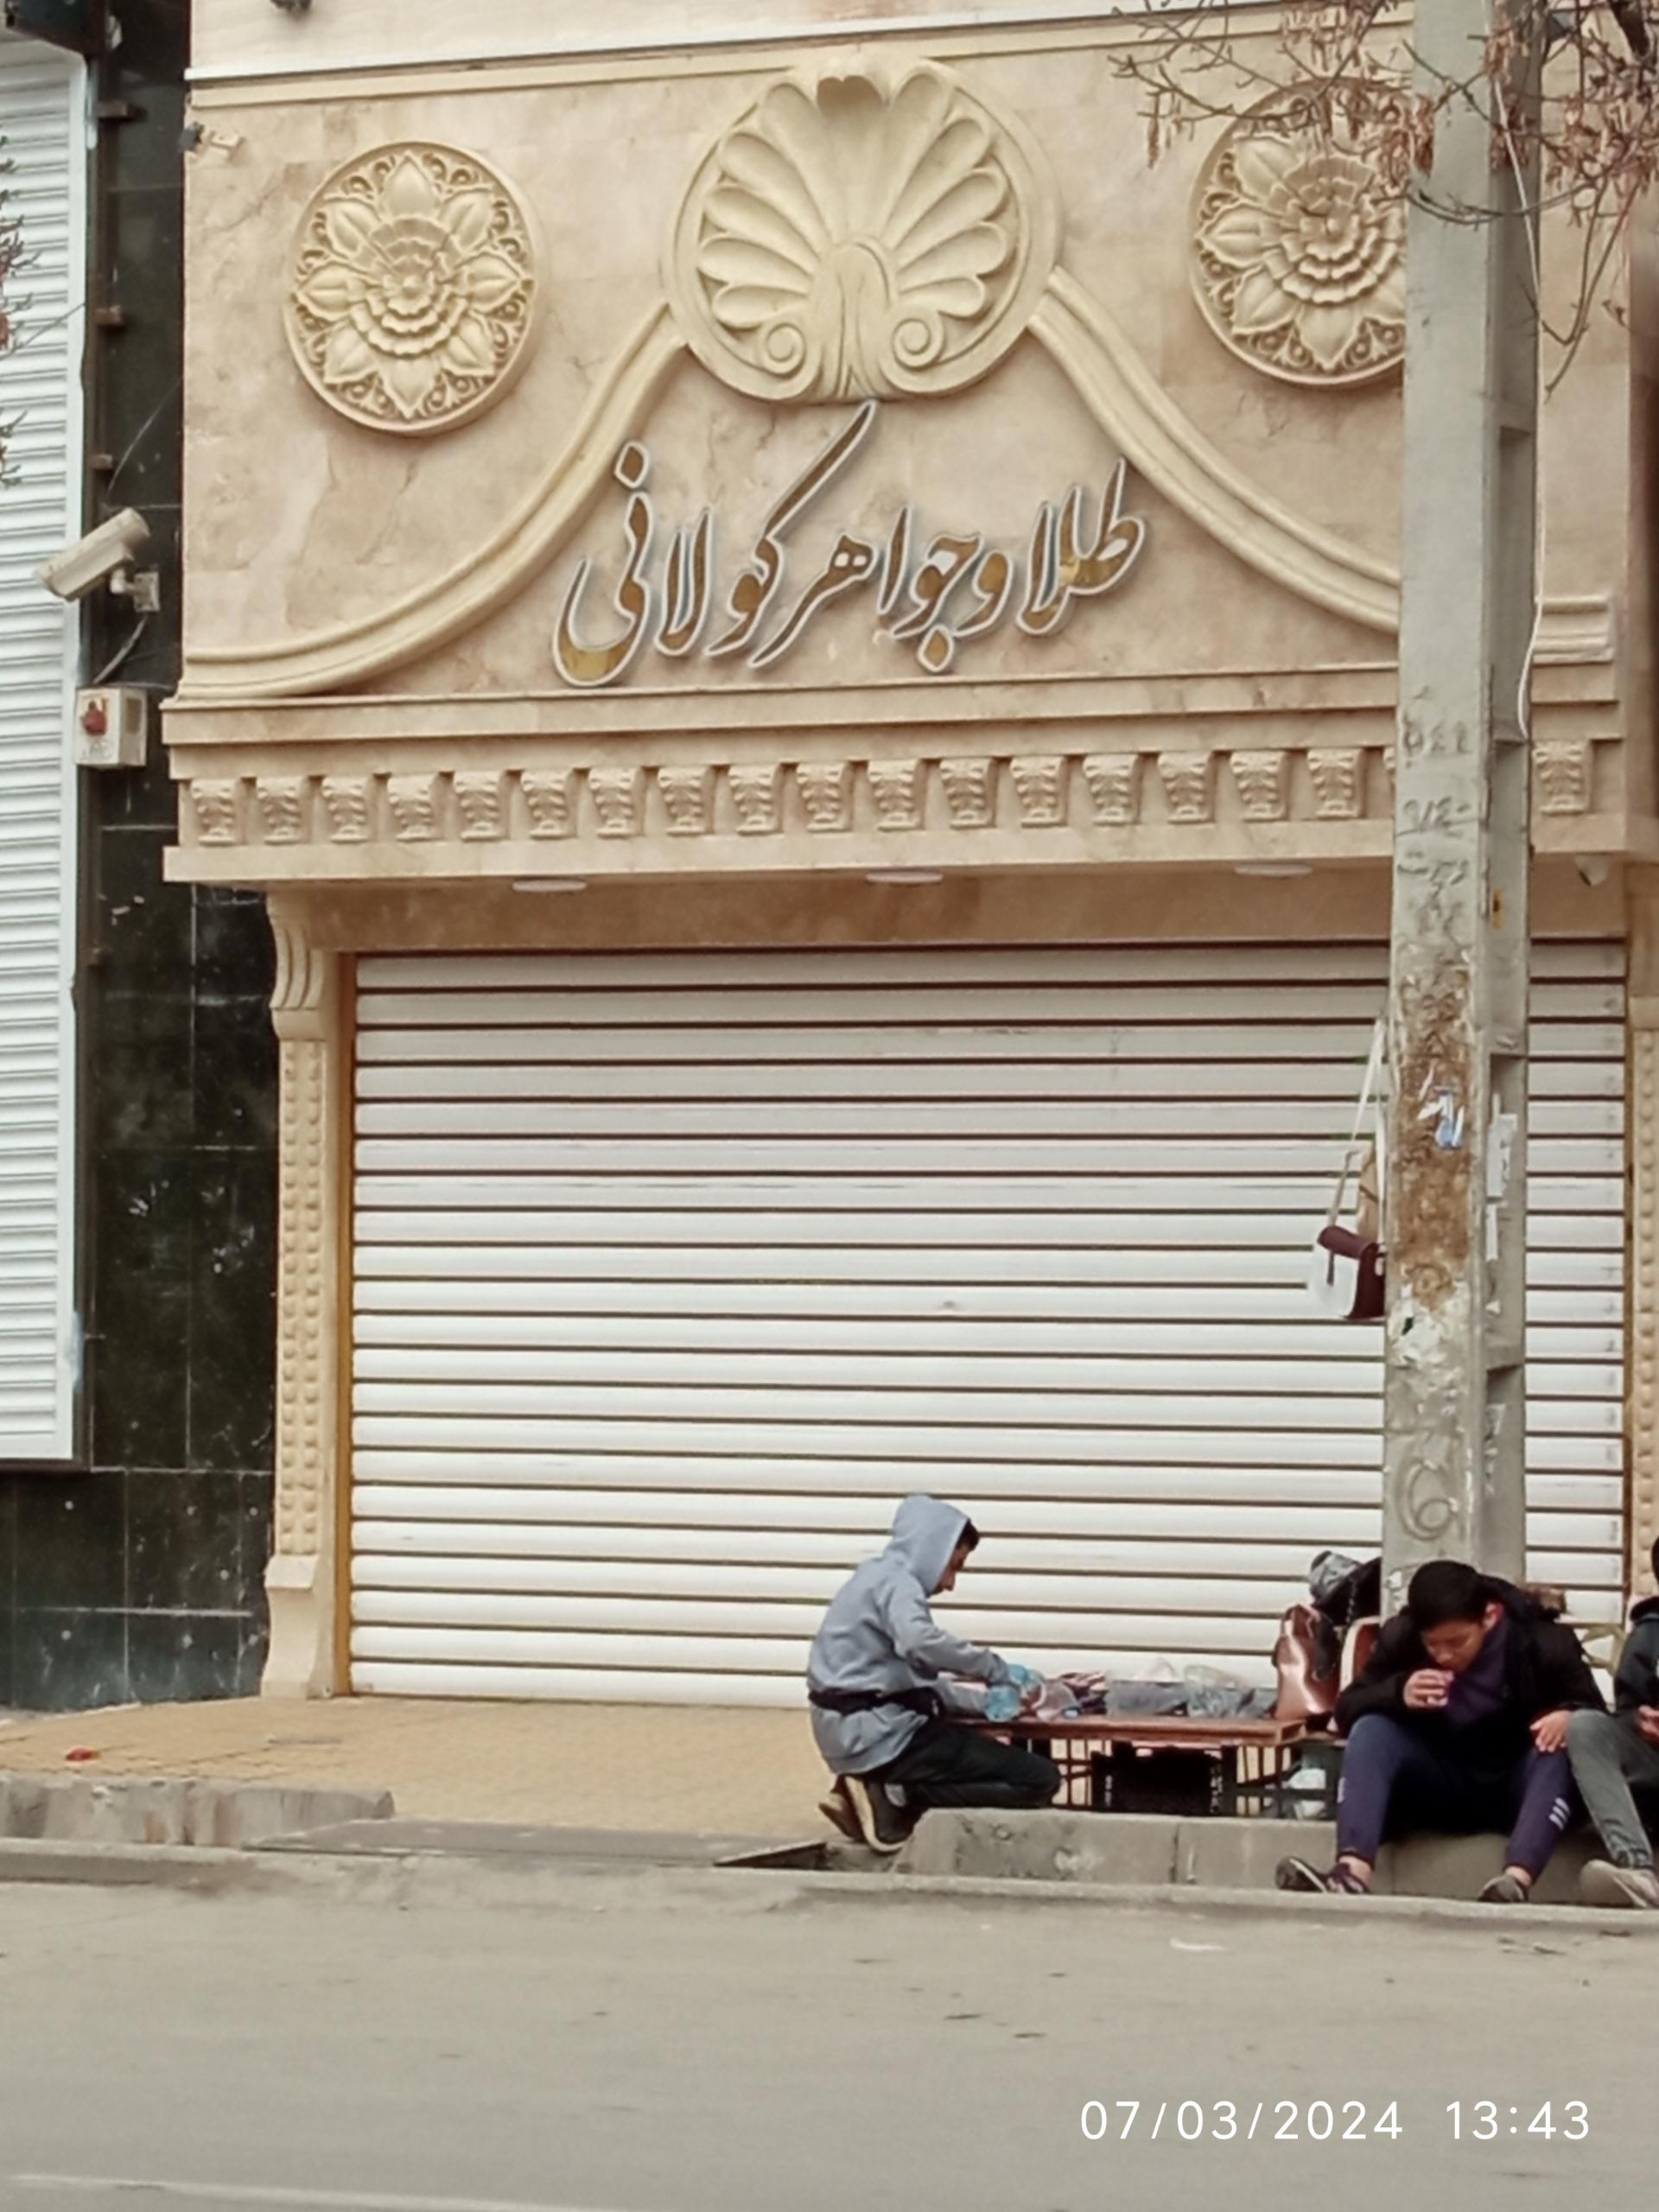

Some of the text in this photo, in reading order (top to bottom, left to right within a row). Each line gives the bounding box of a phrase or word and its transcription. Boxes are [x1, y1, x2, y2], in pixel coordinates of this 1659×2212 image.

[747, 504, 987, 672] جواهر
[952, 550, 1014, 639] و
[1015, 457, 1147, 636] طلا
